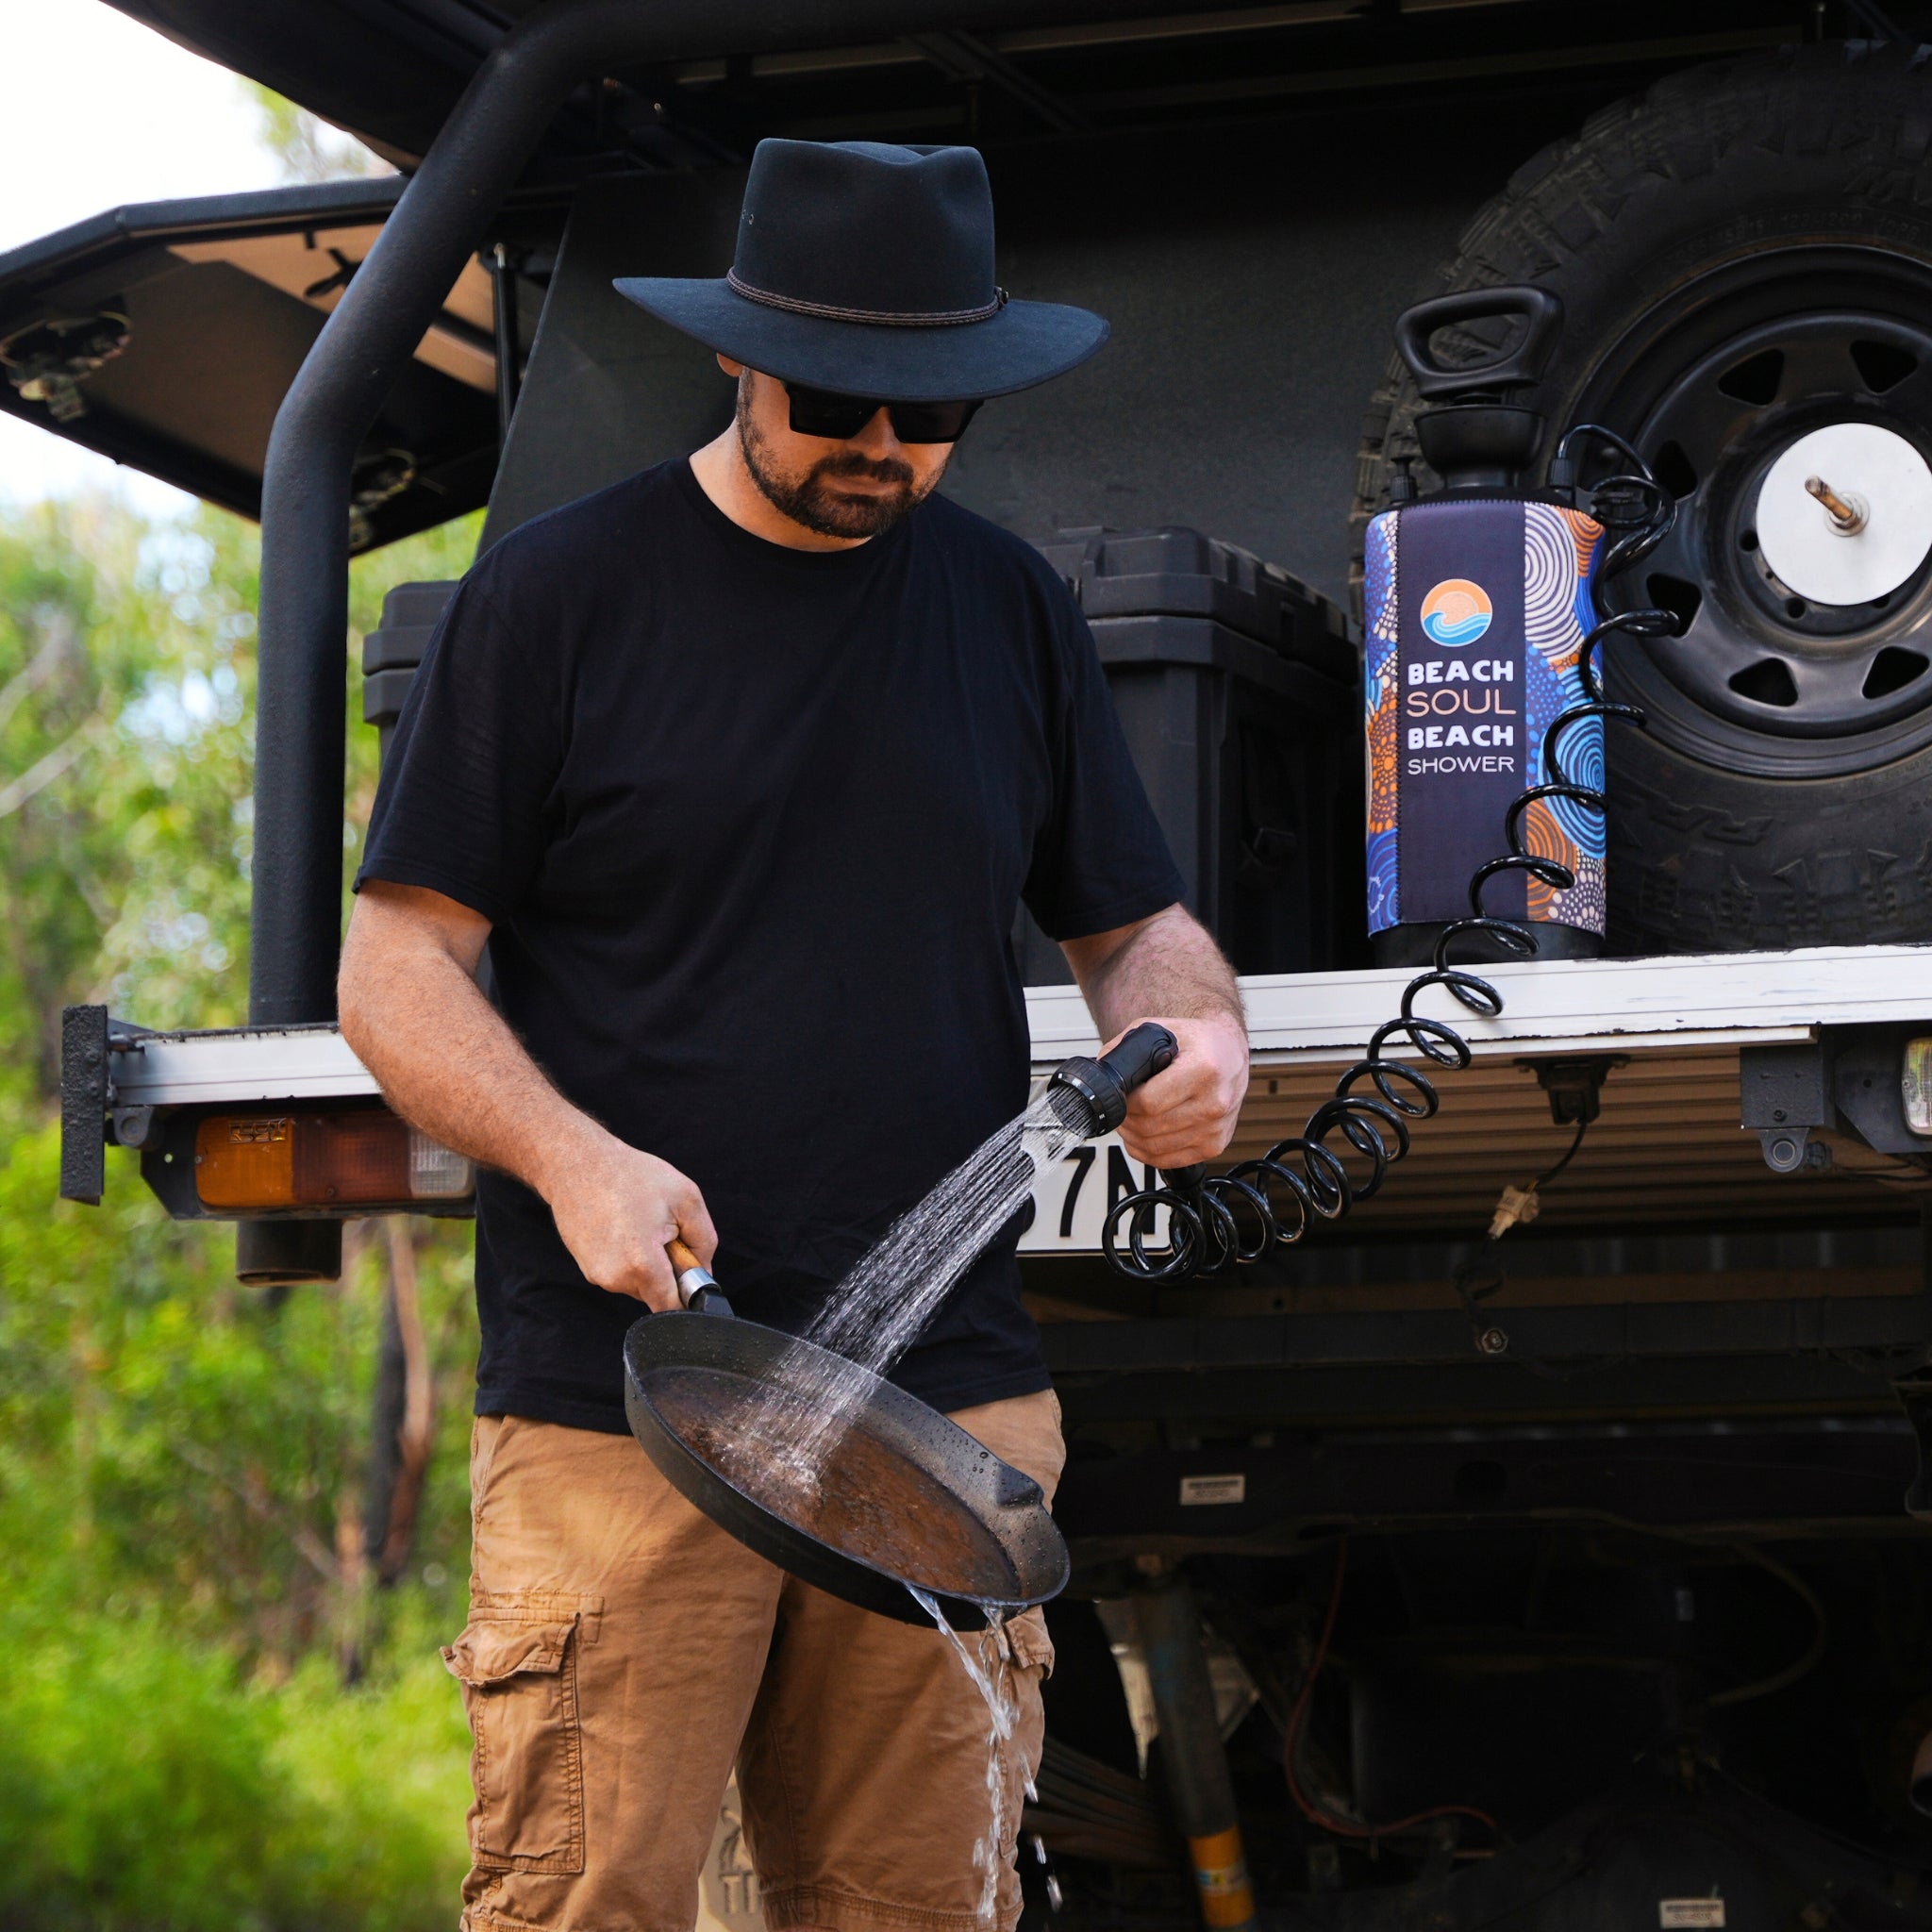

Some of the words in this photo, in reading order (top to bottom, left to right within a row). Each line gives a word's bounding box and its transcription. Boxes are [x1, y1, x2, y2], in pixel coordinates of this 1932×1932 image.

[1407, 659, 1514, 686] BEACH
[1407, 689, 1516, 717] SOUL
[1407, 724, 1514, 750] BEACH
[1407, 757, 1515, 774] SHOWER
[1021, 1144, 1157, 1239] 7N
